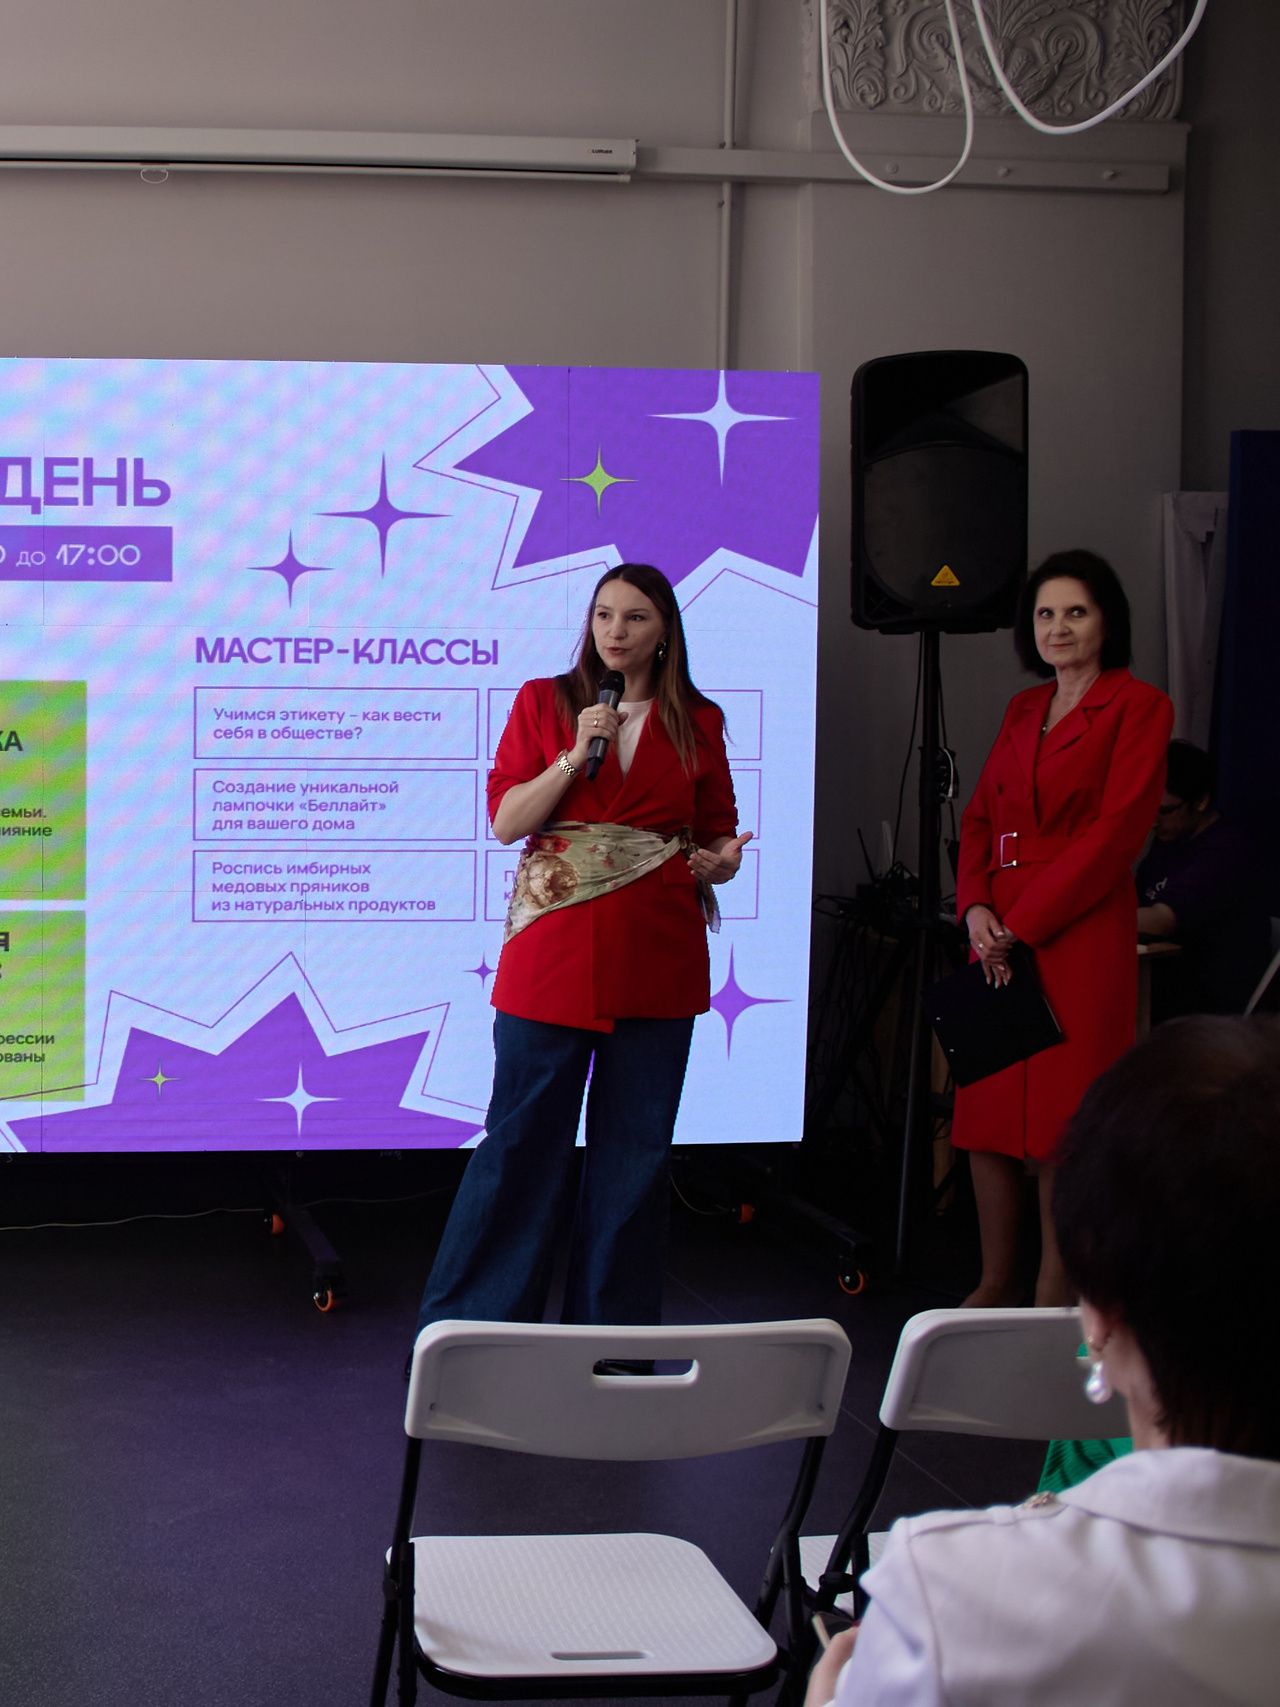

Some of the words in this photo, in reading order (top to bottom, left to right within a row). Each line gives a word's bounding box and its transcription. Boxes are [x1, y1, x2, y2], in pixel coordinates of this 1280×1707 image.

[15, 550, 47, 568] до
[56, 544, 140, 565] 17:00
[196, 637, 498, 665] МАСТЕР-КЛАССЫ
[214, 707, 275, 722] Учимся
[280, 710, 345, 726] этикету
[362, 710, 389, 722] как
[394, 710, 441, 722] вести
[213, 725, 253, 740] себя
[257, 728, 268, 740] в
[271, 725, 363, 741] обществе?
[213, 779, 296, 795] Создание
[300, 780, 399, 797] уникальной
[213, 800, 294, 814] лампочки
[299, 798, 386, 813] «Беллайт»
[212, 819, 243, 832] для
[248, 818, 309, 831] вашего
[312, 819, 355, 832] дома
[212, 861, 282, 877] Роспись
[287, 861, 371, 878] имбирных
[212, 881, 286, 895] медовых
[290, 881, 369, 897] пряников
[211, 900, 231, 912] из
[235, 899, 344, 915] натуральных
[348, 899, 435, 915] продуктов
